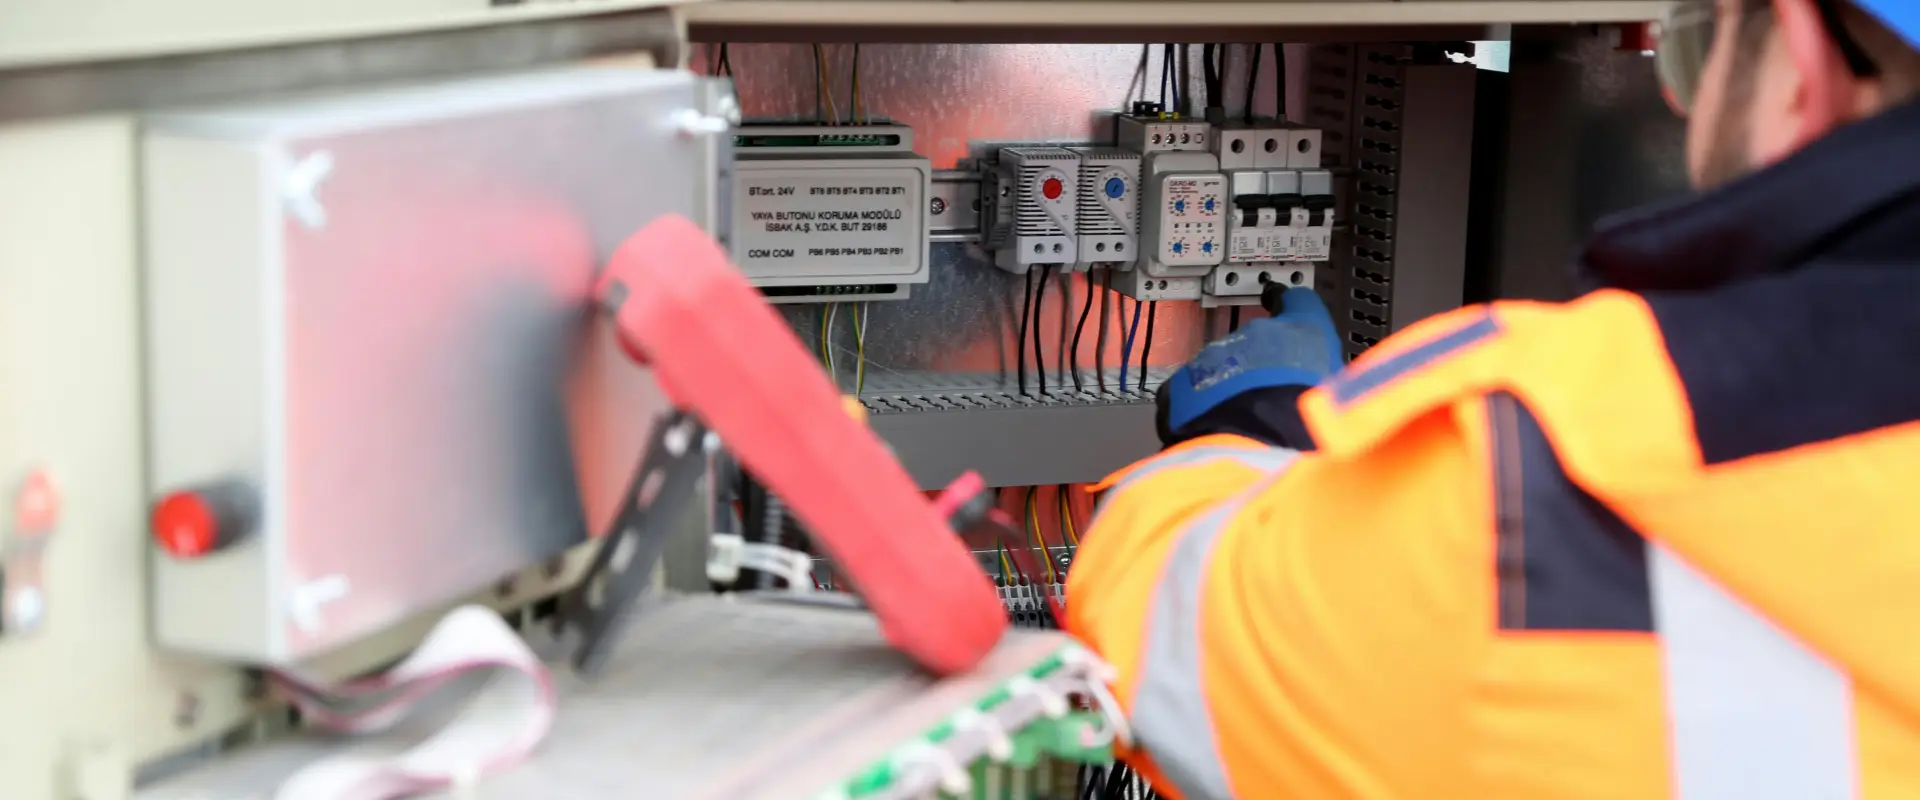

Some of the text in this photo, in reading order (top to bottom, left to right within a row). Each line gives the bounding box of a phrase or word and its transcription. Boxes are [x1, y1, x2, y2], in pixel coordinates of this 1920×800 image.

[777, 187, 795, 195] 24V
[843, 187, 857, 195] BT4
[859, 187, 873, 195] BT3
[875, 187, 890, 195] BT2
[891, 187, 905, 195] BT1
[751, 208, 901, 220] YAYA BUTONU KORUMA MODÜLÜ
[766, 221, 792, 232] İSBAK
[795, 222, 811, 234] A.Ş.
[815, 222, 838, 231] Y.D.K.
[841, 222, 859, 231] BUT
[748, 248, 794, 258] COM COM
